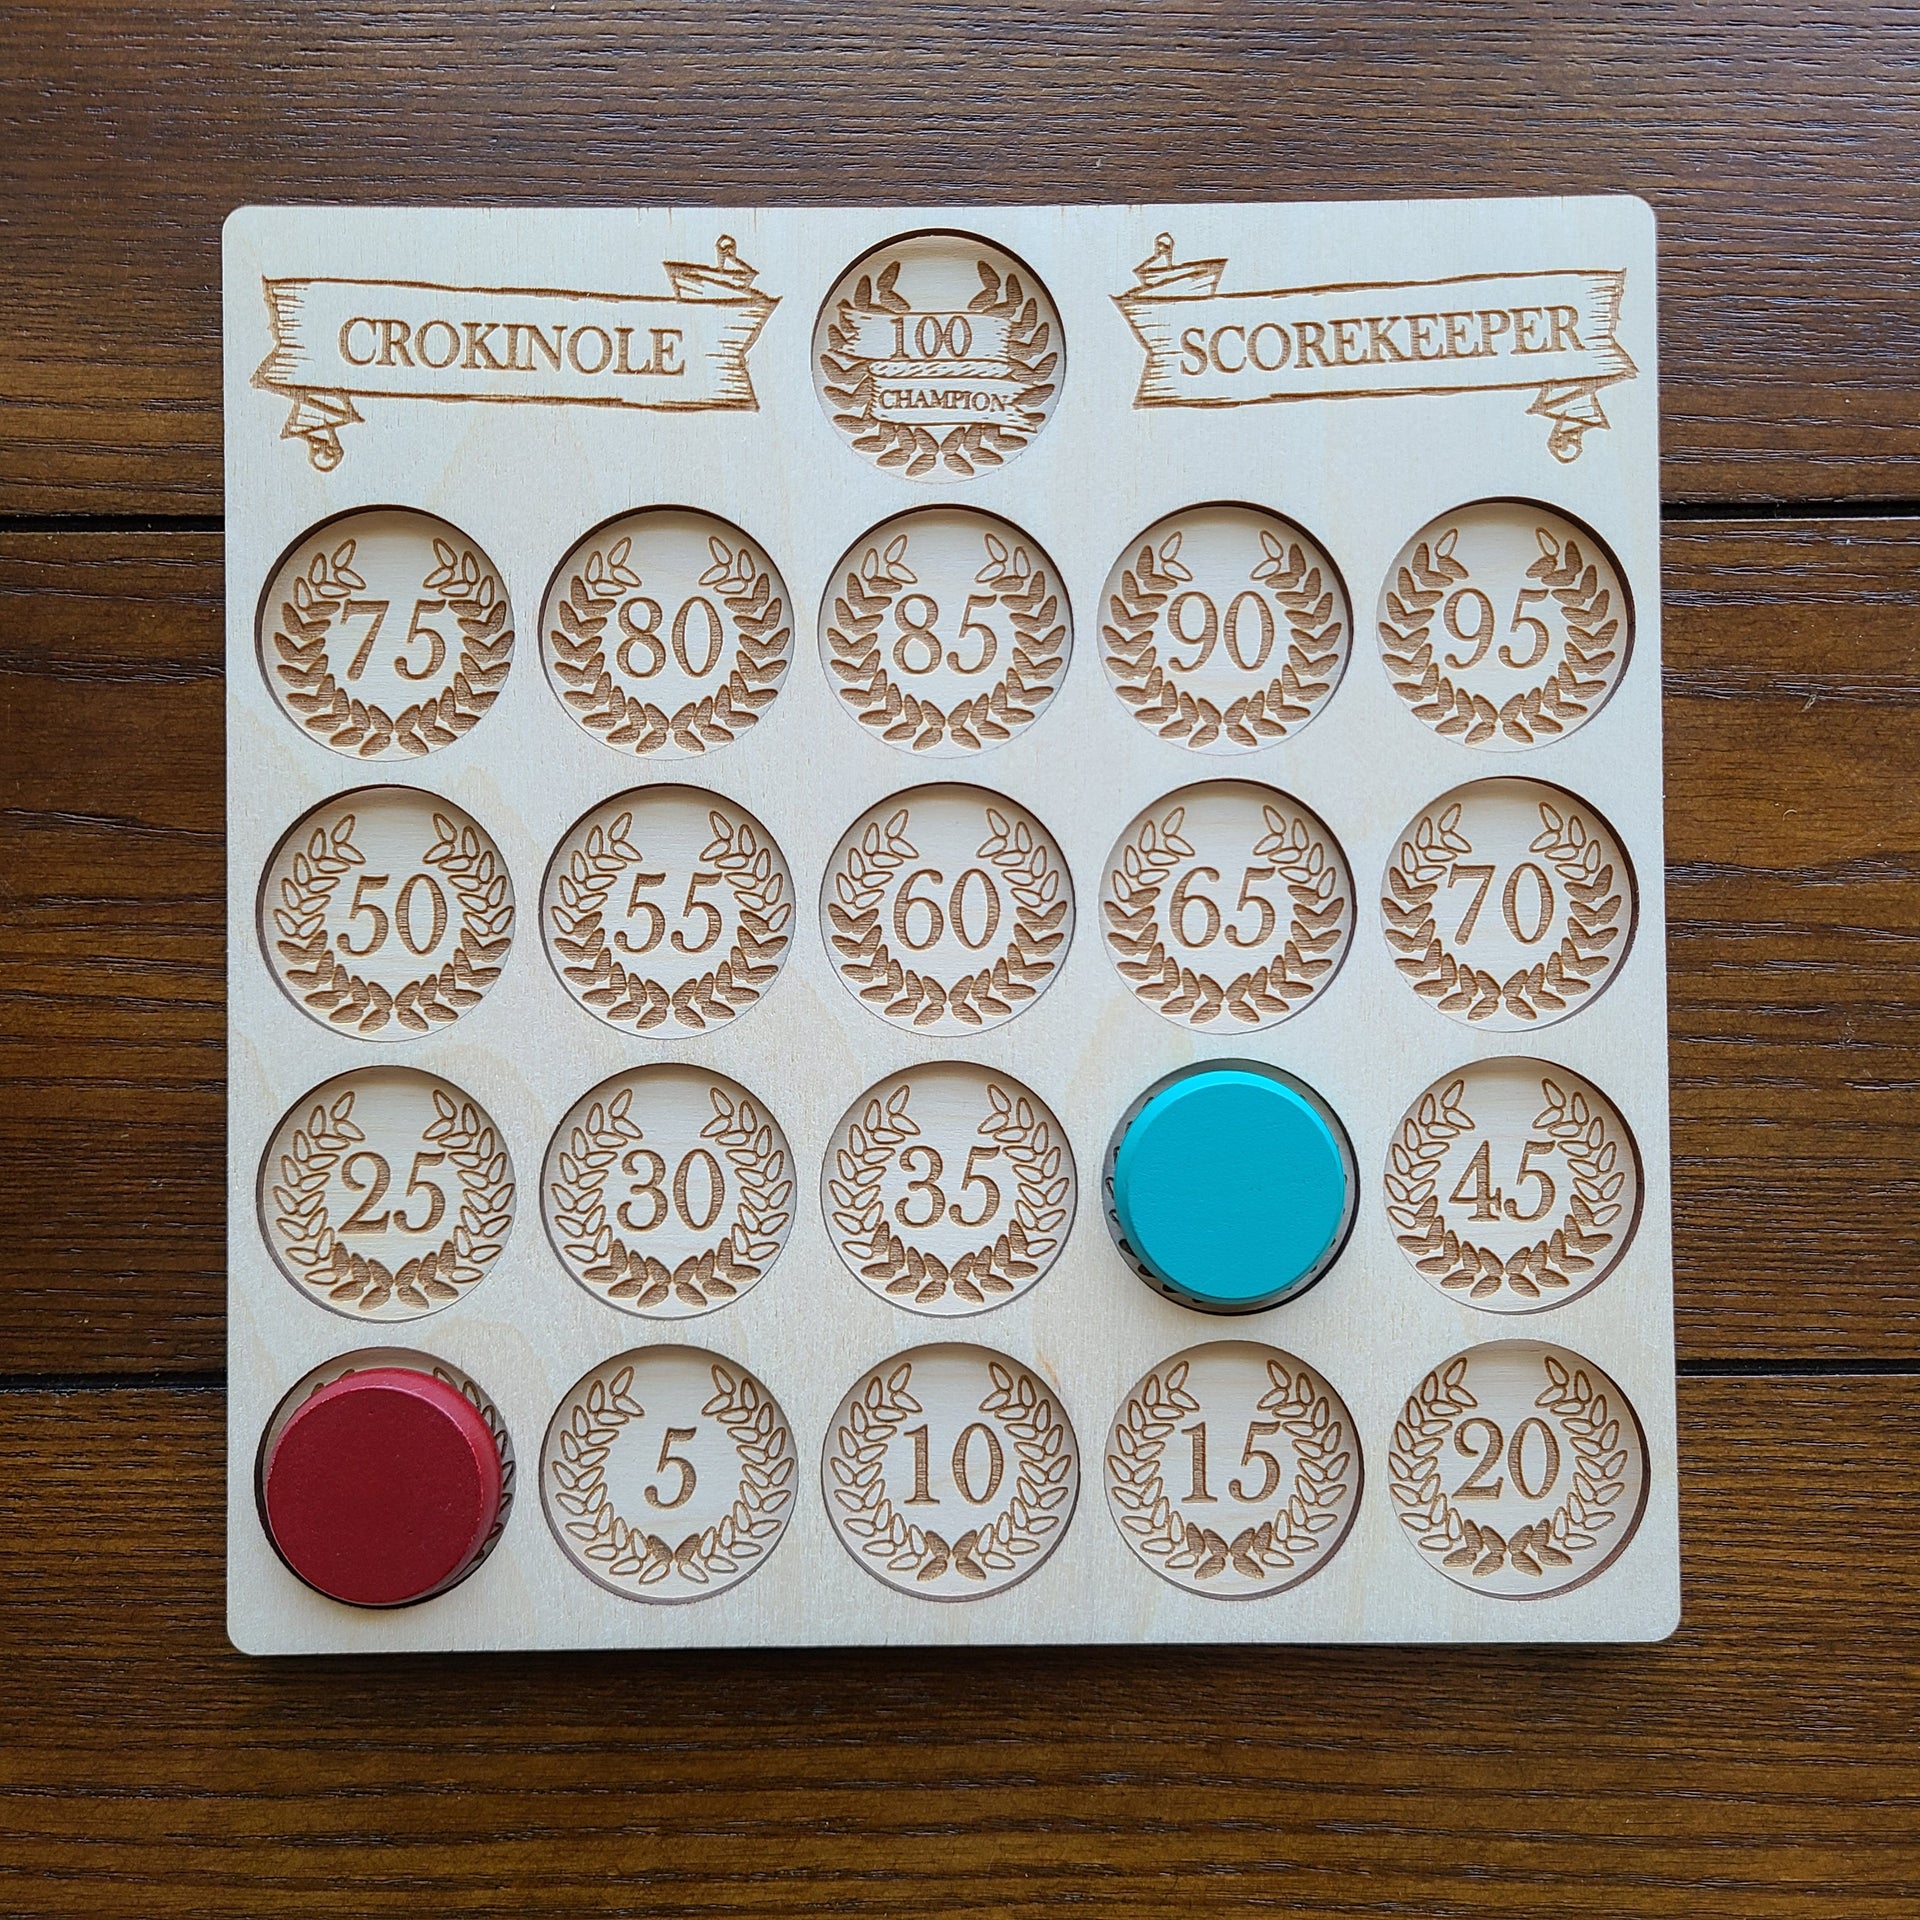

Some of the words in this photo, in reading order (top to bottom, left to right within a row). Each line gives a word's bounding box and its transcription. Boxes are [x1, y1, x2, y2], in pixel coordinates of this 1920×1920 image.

[337, 316, 685, 376] CROKINOLE
[890, 315, 972, 359] 100
[1179, 304, 1586, 376] SCOREKEEPER
[878, 389, 1006, 412] CHAMPION
[341, 599, 447, 680] 75
[616, 596, 723, 678] 80
[893, 594, 997, 674] 85
[1168, 591, 1274, 672] 90
[1444, 588, 1549, 669] 95
[337, 874, 448, 956] 50
[614, 872, 722, 953] 55
[894, 868, 1000, 950] 60
[1170, 866, 1275, 948] 65
[1448, 862, 1554, 944] 70
[338, 1151, 446, 1233] 25
[617, 1149, 725, 1231] 30
[895, 1145, 1000, 1228] 35
[1449, 1140, 1556, 1221] 45
[645, 1427, 697, 1509] 5
[904, 1423, 1004, 1504] 10
[1181, 1421, 1281, 1502] 15
[1451, 1417, 1560, 1499] 20
